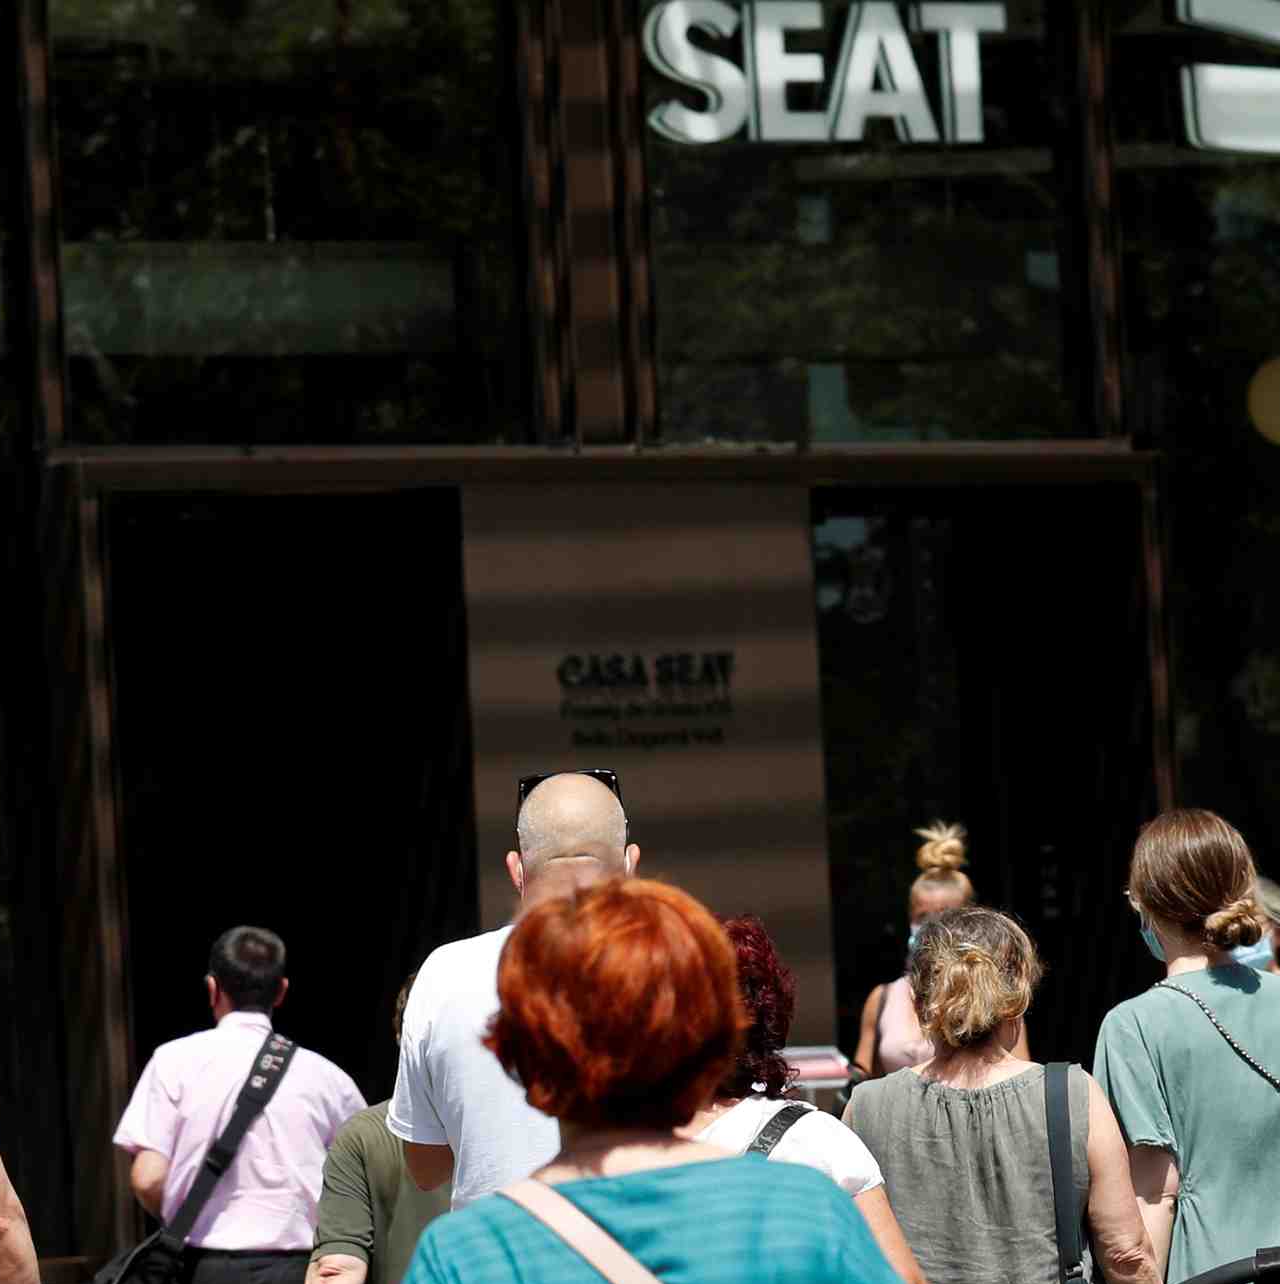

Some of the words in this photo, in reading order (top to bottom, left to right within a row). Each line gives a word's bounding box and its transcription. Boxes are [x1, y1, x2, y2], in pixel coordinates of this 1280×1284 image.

[642, 0, 1008, 144] SEAT
[557, 653, 649, 689] CASA
[656, 653, 736, 689] SEAT
